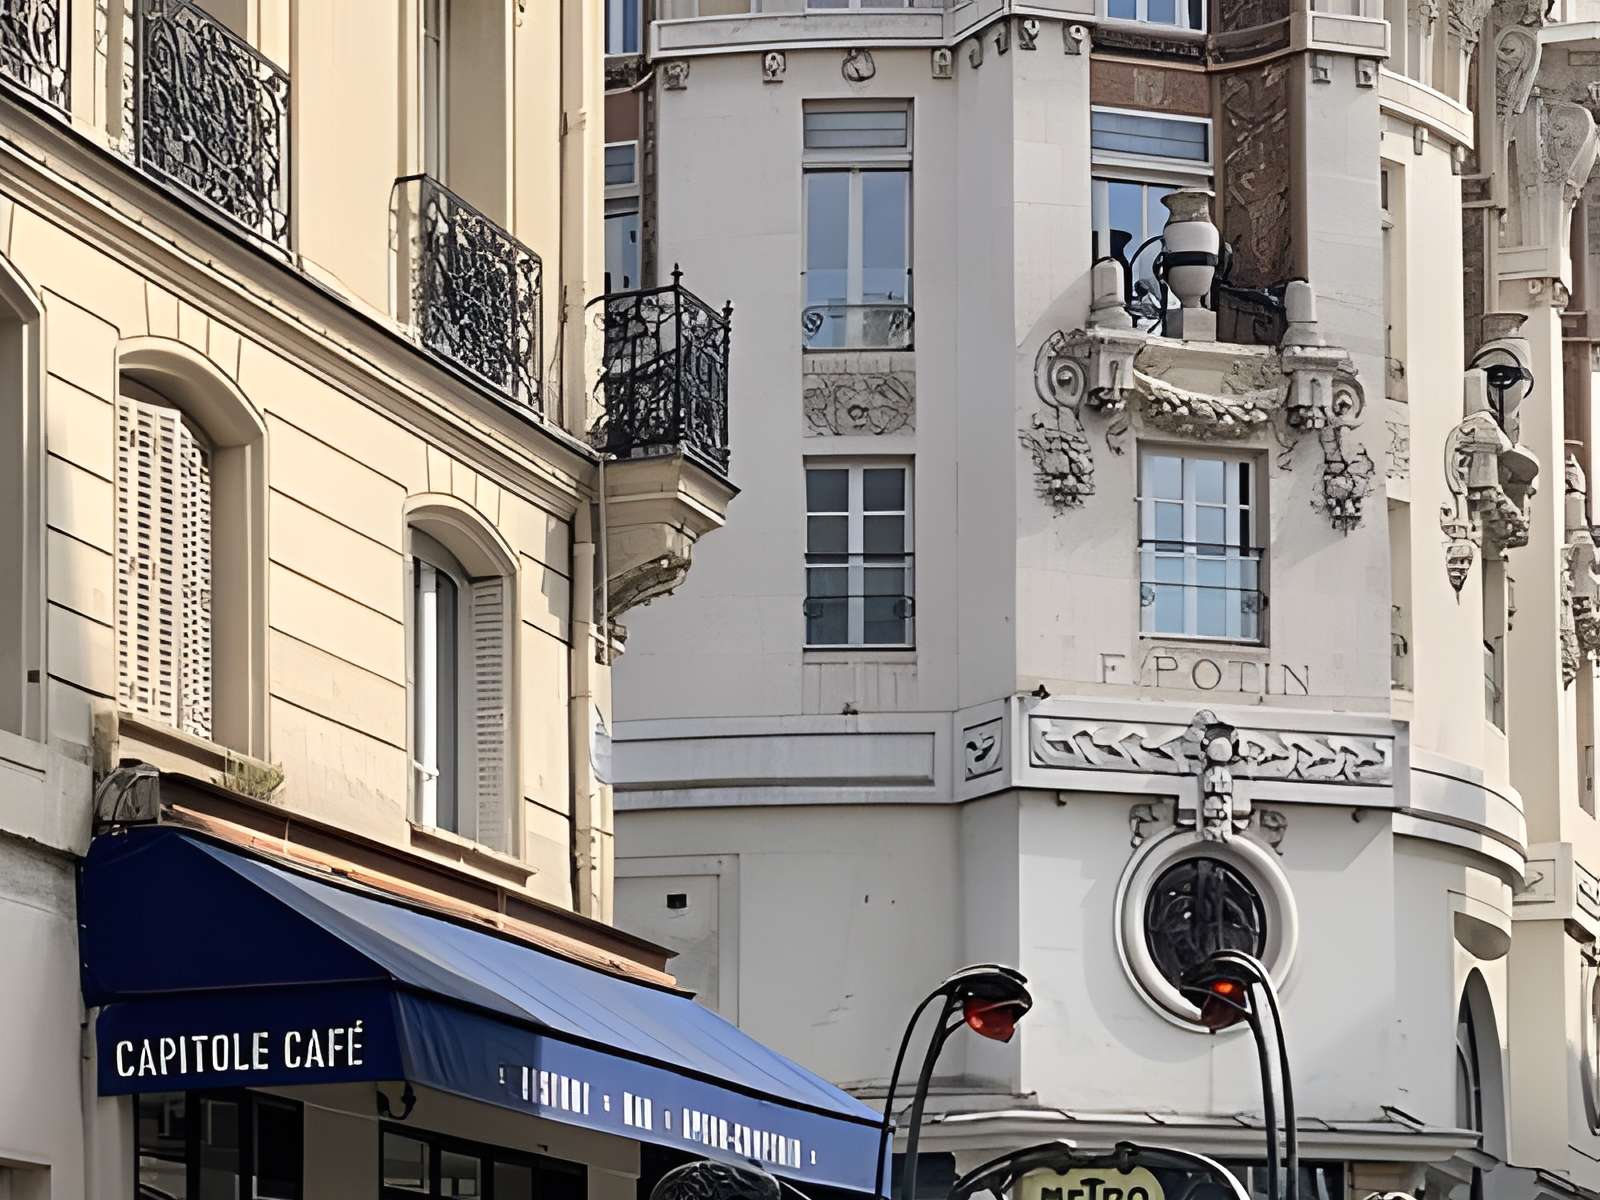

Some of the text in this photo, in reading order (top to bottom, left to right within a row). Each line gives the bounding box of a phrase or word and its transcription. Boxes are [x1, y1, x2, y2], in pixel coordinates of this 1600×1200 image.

[1152, 655, 1310, 696] POTIN
[116, 1019, 364, 1077] CAPITOLE CAFÉ
